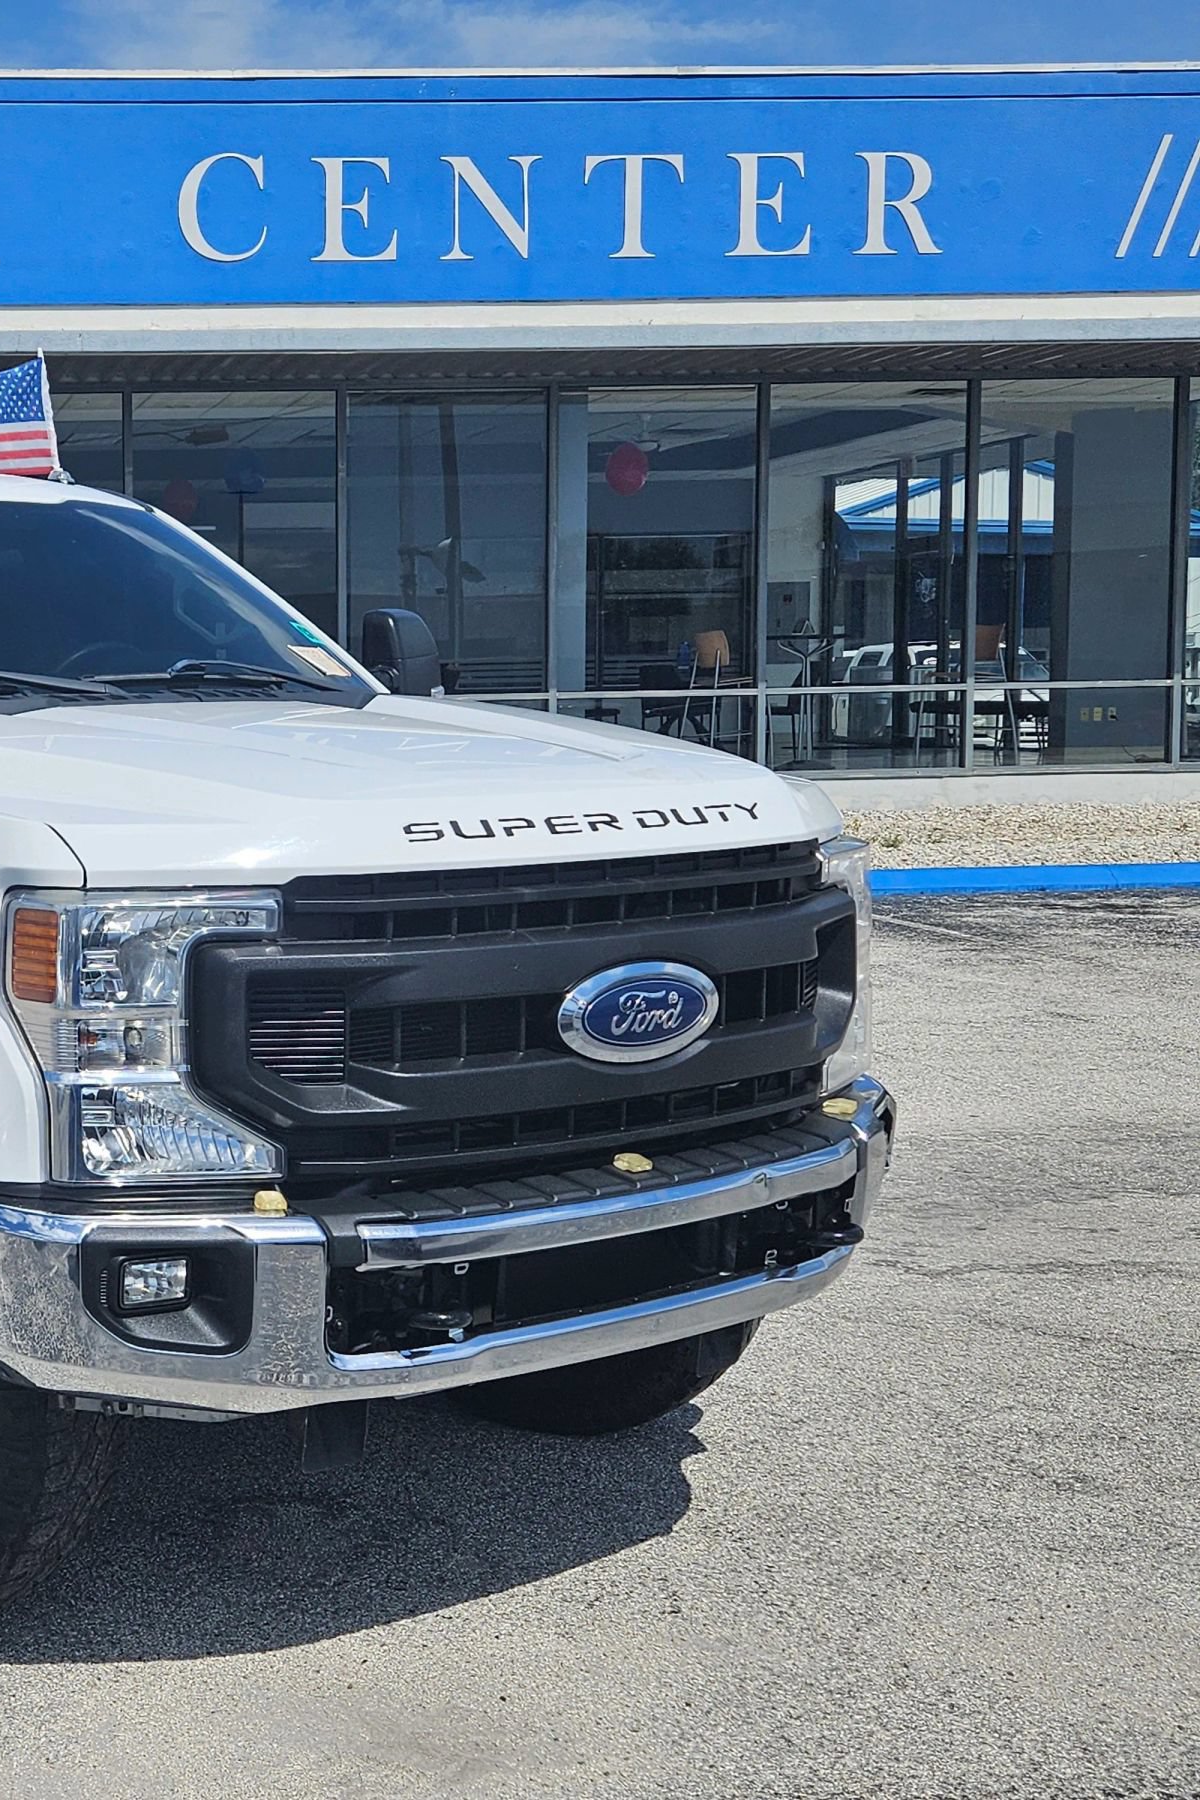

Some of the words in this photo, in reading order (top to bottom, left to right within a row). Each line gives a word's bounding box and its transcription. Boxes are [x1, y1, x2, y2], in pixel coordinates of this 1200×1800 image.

[178, 151, 944, 264] CENTER
[403, 813, 623, 842] SUPER
[632, 802, 758, 828] DUTY
[611, 990, 684, 1036] Ford
